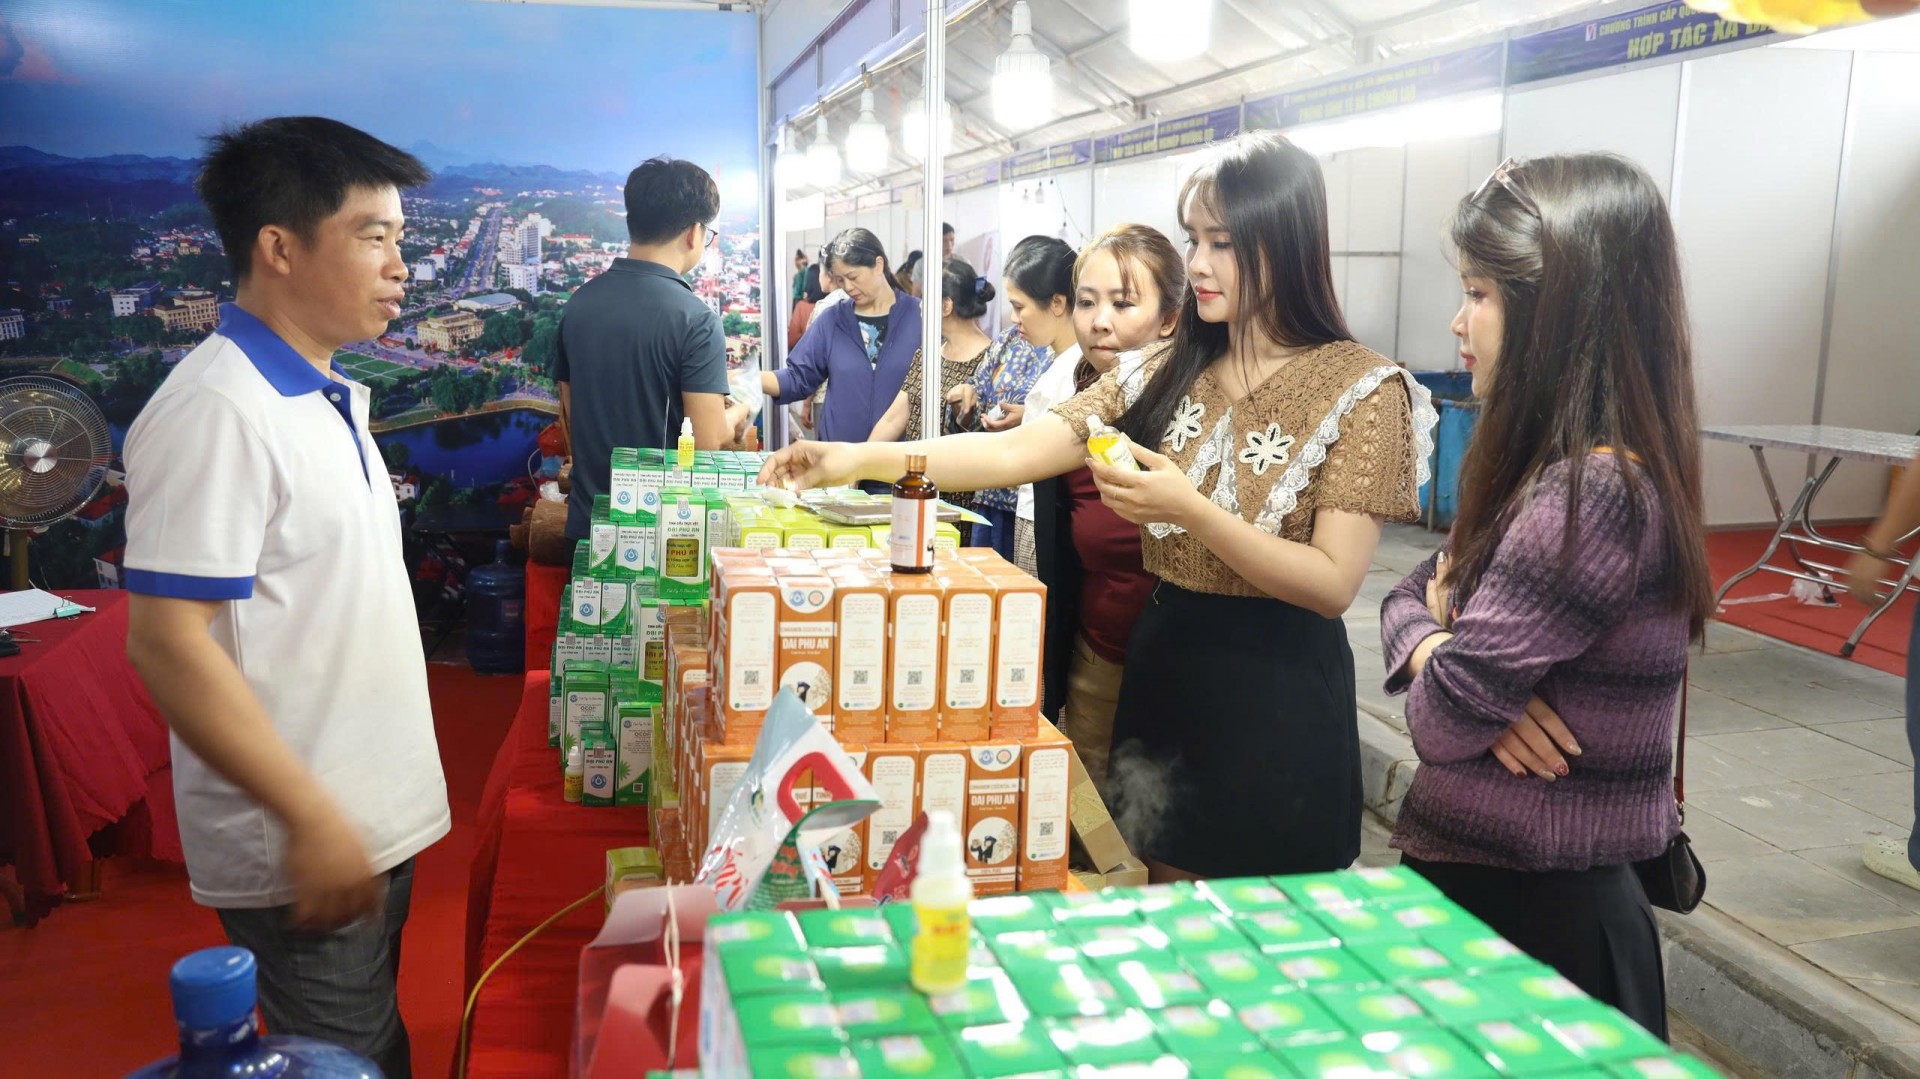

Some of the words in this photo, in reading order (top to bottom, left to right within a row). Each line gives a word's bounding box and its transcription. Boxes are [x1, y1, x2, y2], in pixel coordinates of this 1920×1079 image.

[1627, 31, 1665, 60] HỢP
[1670, 22, 1707, 49] TÁC
[782, 638, 797, 650] DAI
[798, 638, 816, 650] PHU
[816, 638, 830, 650] AN
[971, 794, 985, 806] DAI
[986, 794, 1002, 806] PHU
[1004, 794, 1016, 805] AN
